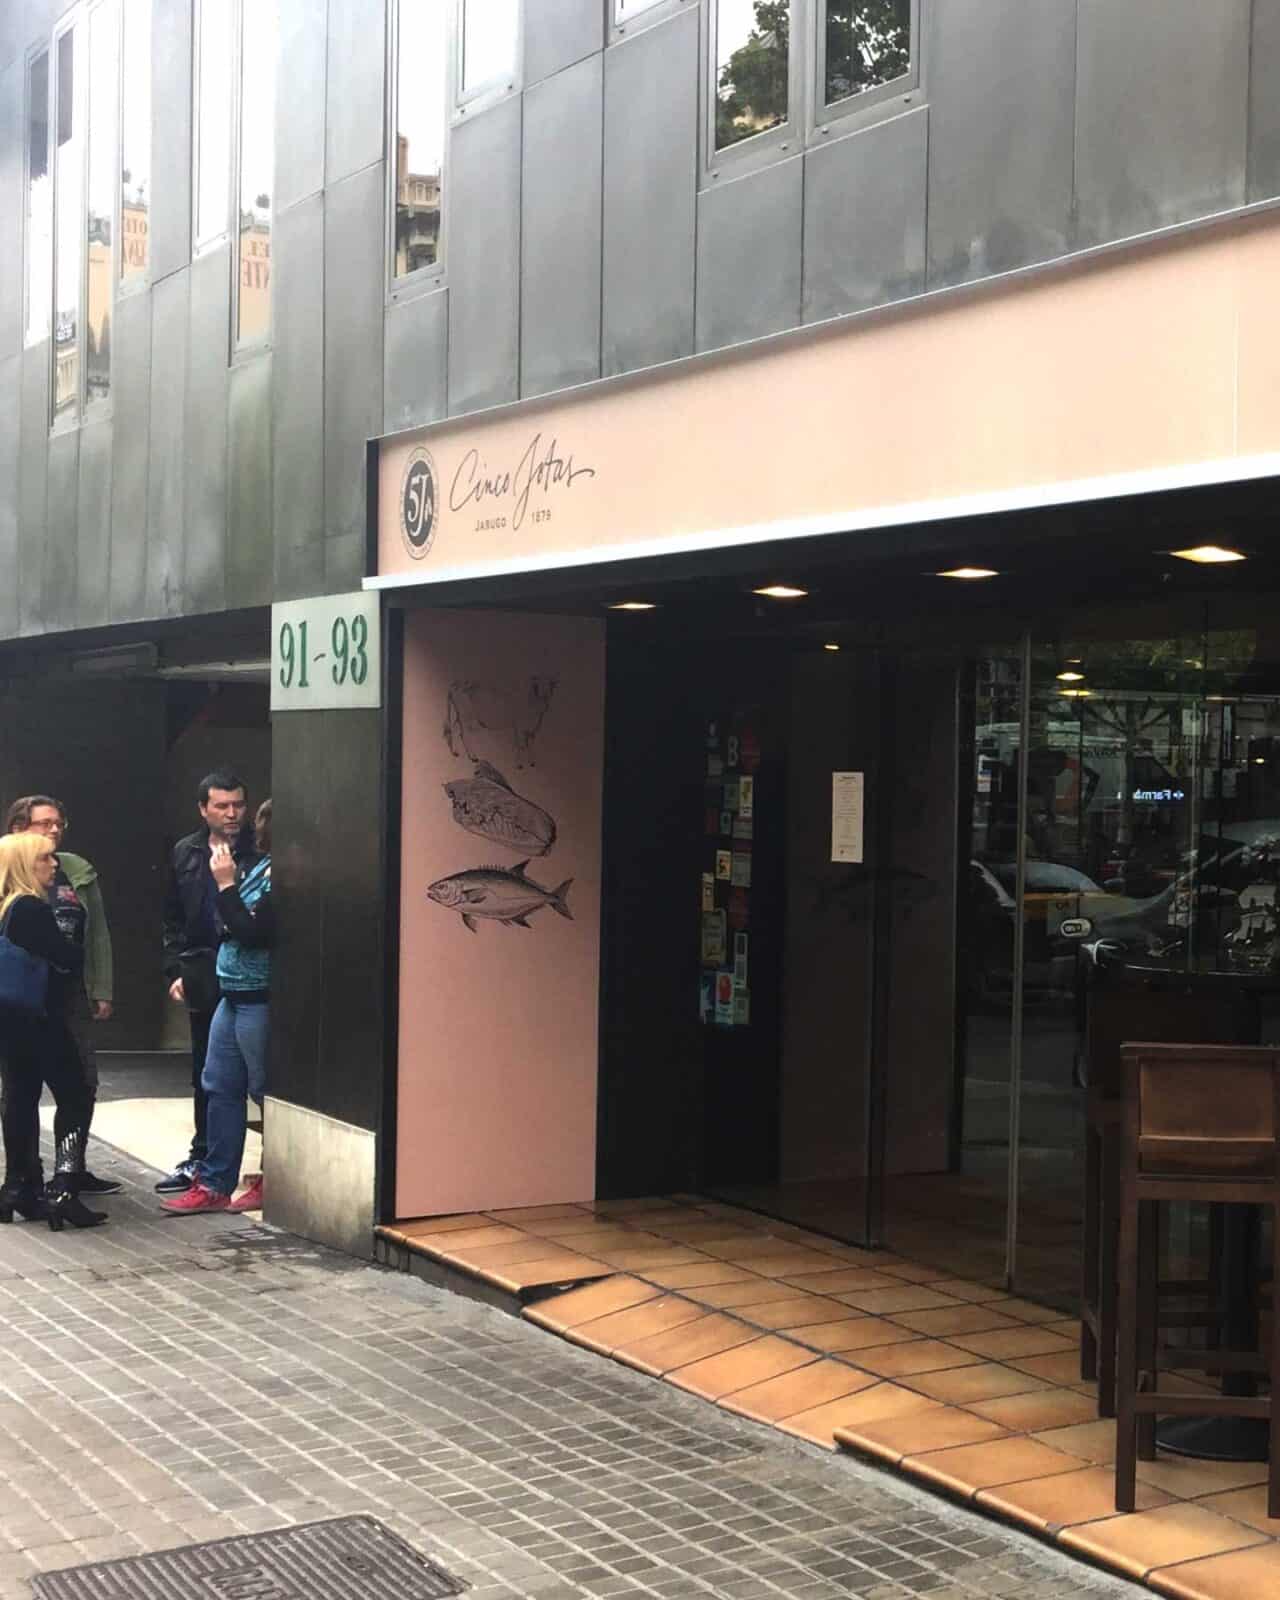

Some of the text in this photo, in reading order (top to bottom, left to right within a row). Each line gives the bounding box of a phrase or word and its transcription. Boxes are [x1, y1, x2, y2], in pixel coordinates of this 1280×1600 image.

[449, 449, 510, 512] Cinco
[513, 433, 595, 532] Jotas
[279, 614, 368, 688] 91-93
